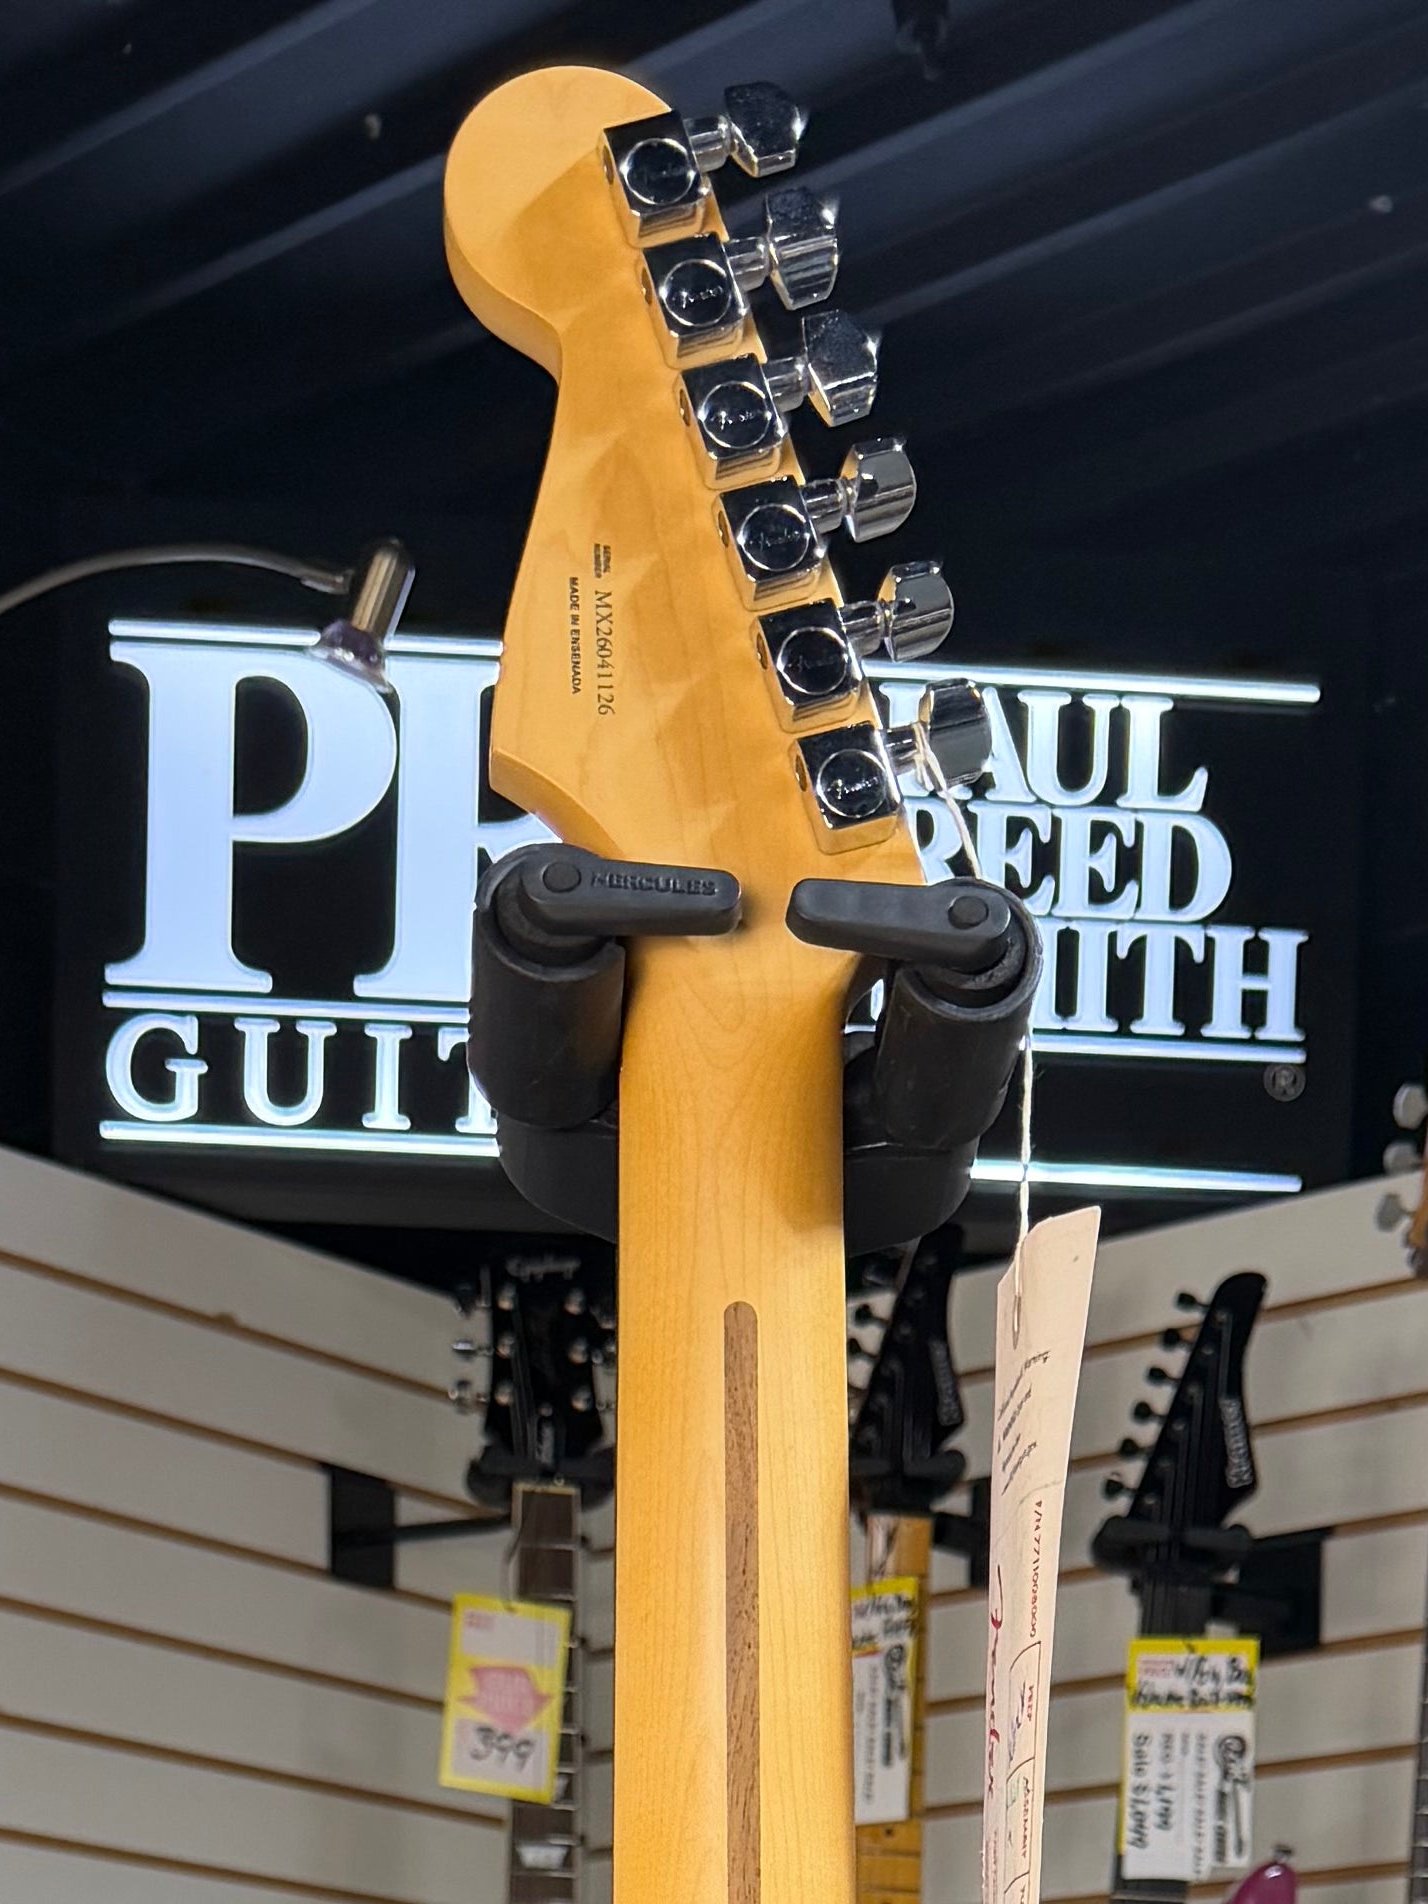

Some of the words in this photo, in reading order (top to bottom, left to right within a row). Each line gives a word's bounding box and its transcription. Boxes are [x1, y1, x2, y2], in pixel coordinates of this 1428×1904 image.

[569, 577, 581, 611] MADE
[570, 614, 581, 626] IN
[570, 628, 582, 695] ENSENADA
[594, 590, 616, 716] MX26041126
[590, 869, 719, 897] HERCULES
[1032, 916, 1310, 1043] ITH
